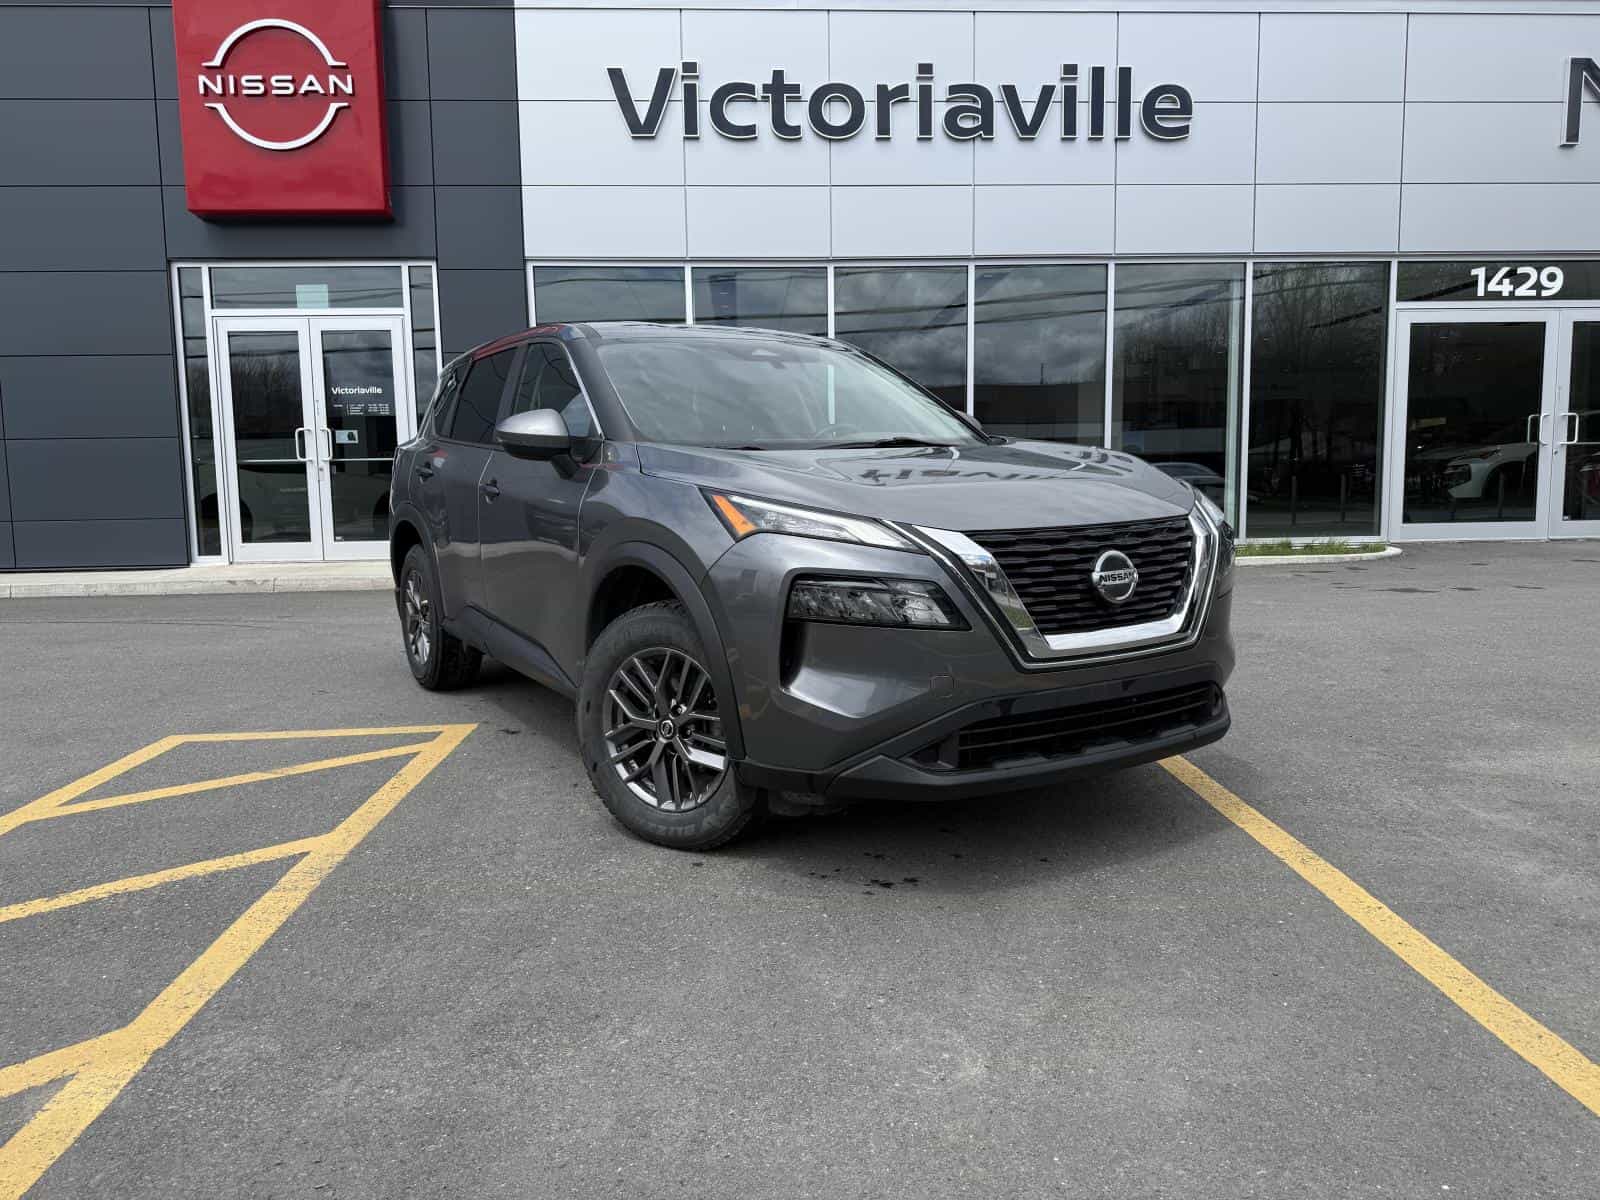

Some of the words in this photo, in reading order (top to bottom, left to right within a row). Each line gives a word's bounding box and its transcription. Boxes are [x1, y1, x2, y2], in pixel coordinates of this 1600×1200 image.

[198, 74, 353, 95] NISSAN
[606, 61, 1194, 140] Victoriaville
[1470, 266, 1564, 297] 1429
[331, 386, 383, 395] Victoriaville
[1099, 571, 1134, 583] NISSAN
